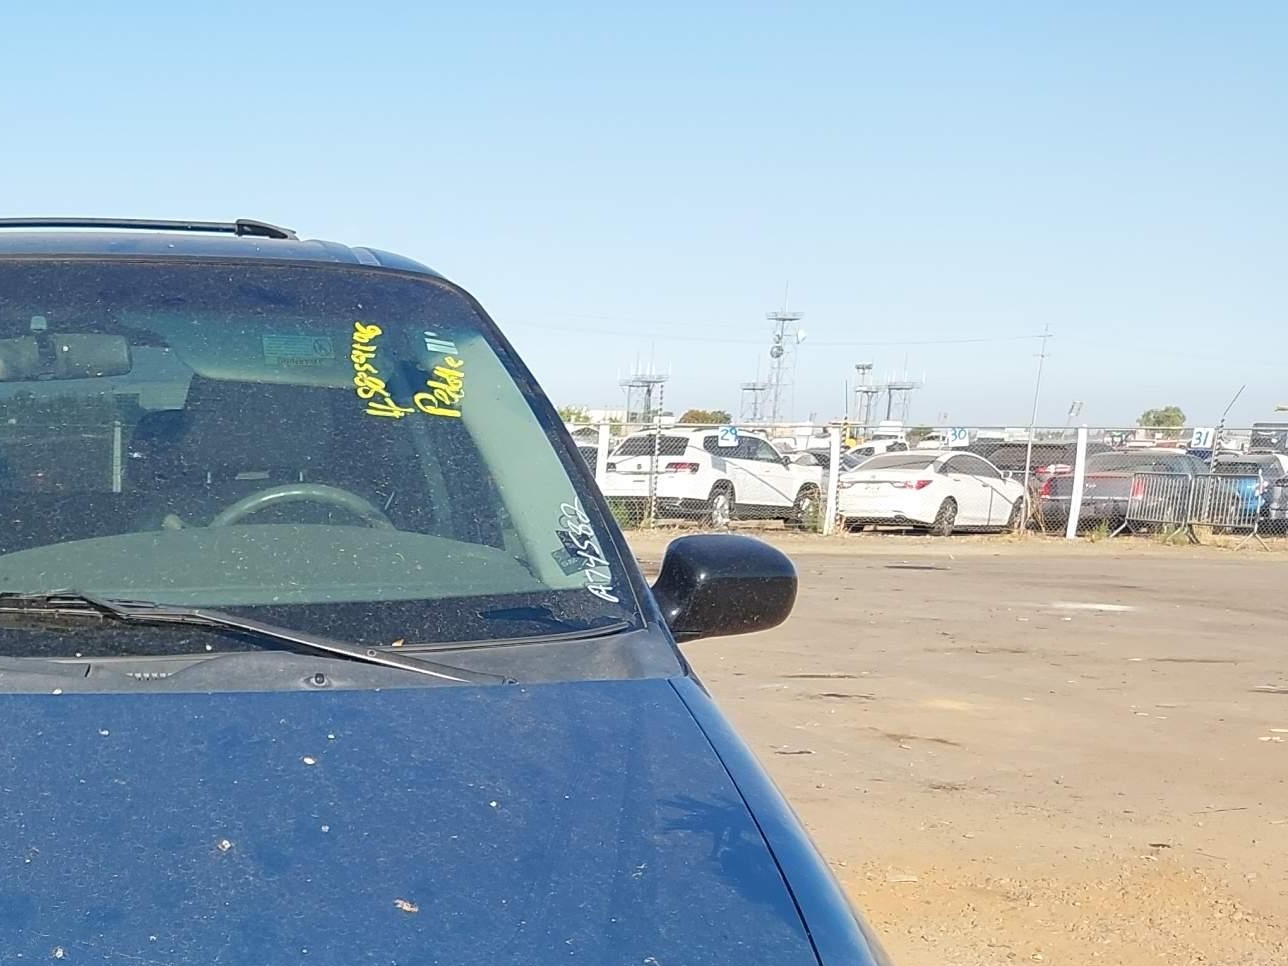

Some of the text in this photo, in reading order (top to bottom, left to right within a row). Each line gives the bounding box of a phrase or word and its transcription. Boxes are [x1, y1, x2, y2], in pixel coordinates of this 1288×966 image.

[720, 426, 738, 442] 29
[951, 426, 968, 442] 30
[1193, 430, 1210, 447] 31
[560, 496, 620, 604] A74582
